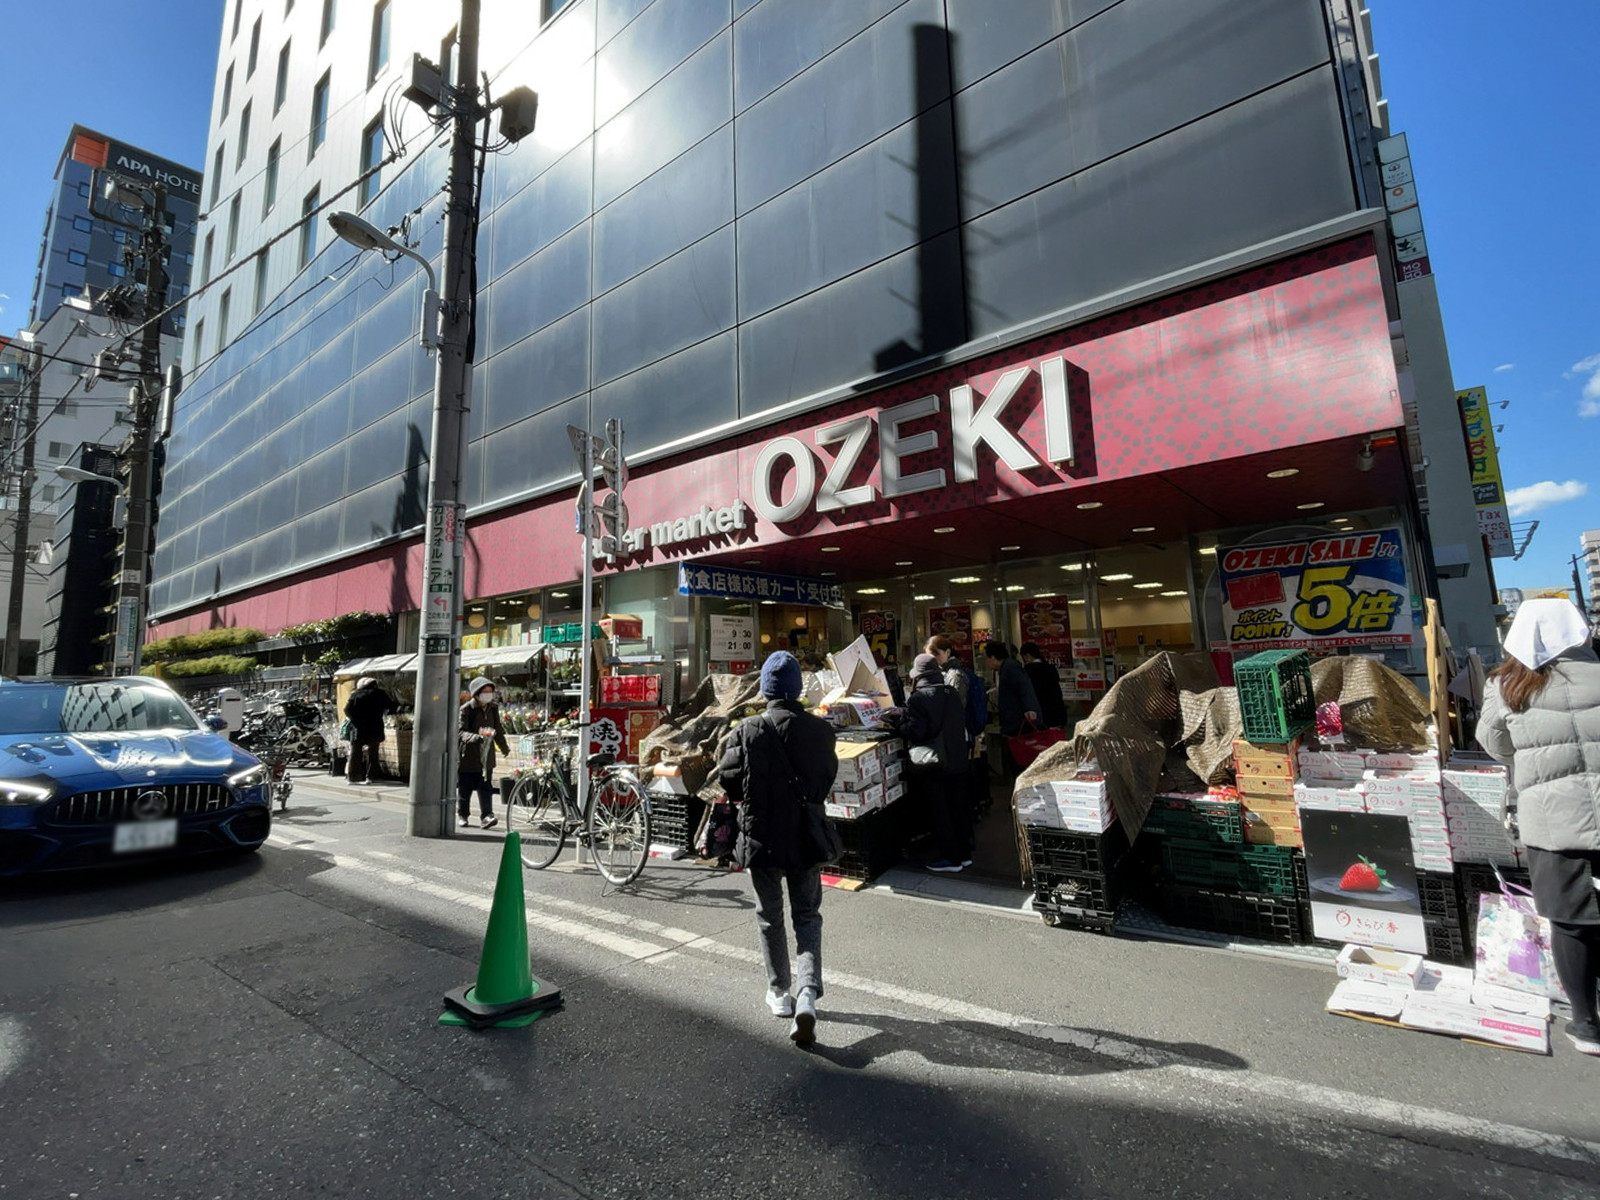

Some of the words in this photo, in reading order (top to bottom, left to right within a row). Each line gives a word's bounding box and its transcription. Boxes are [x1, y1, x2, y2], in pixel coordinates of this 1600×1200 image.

[117, 155, 152, 177] APA
[155, 169, 200, 195] HOTE
[752, 355, 1074, 523] OZEKI
[650, 499, 748, 547] market
[1477, 510, 1502, 521] Tax
[430, 505, 444, 583] カリフォルニア
[1223, 542, 1309, 573] OZEKI
[1238, 608, 1283, 624] ポイント
